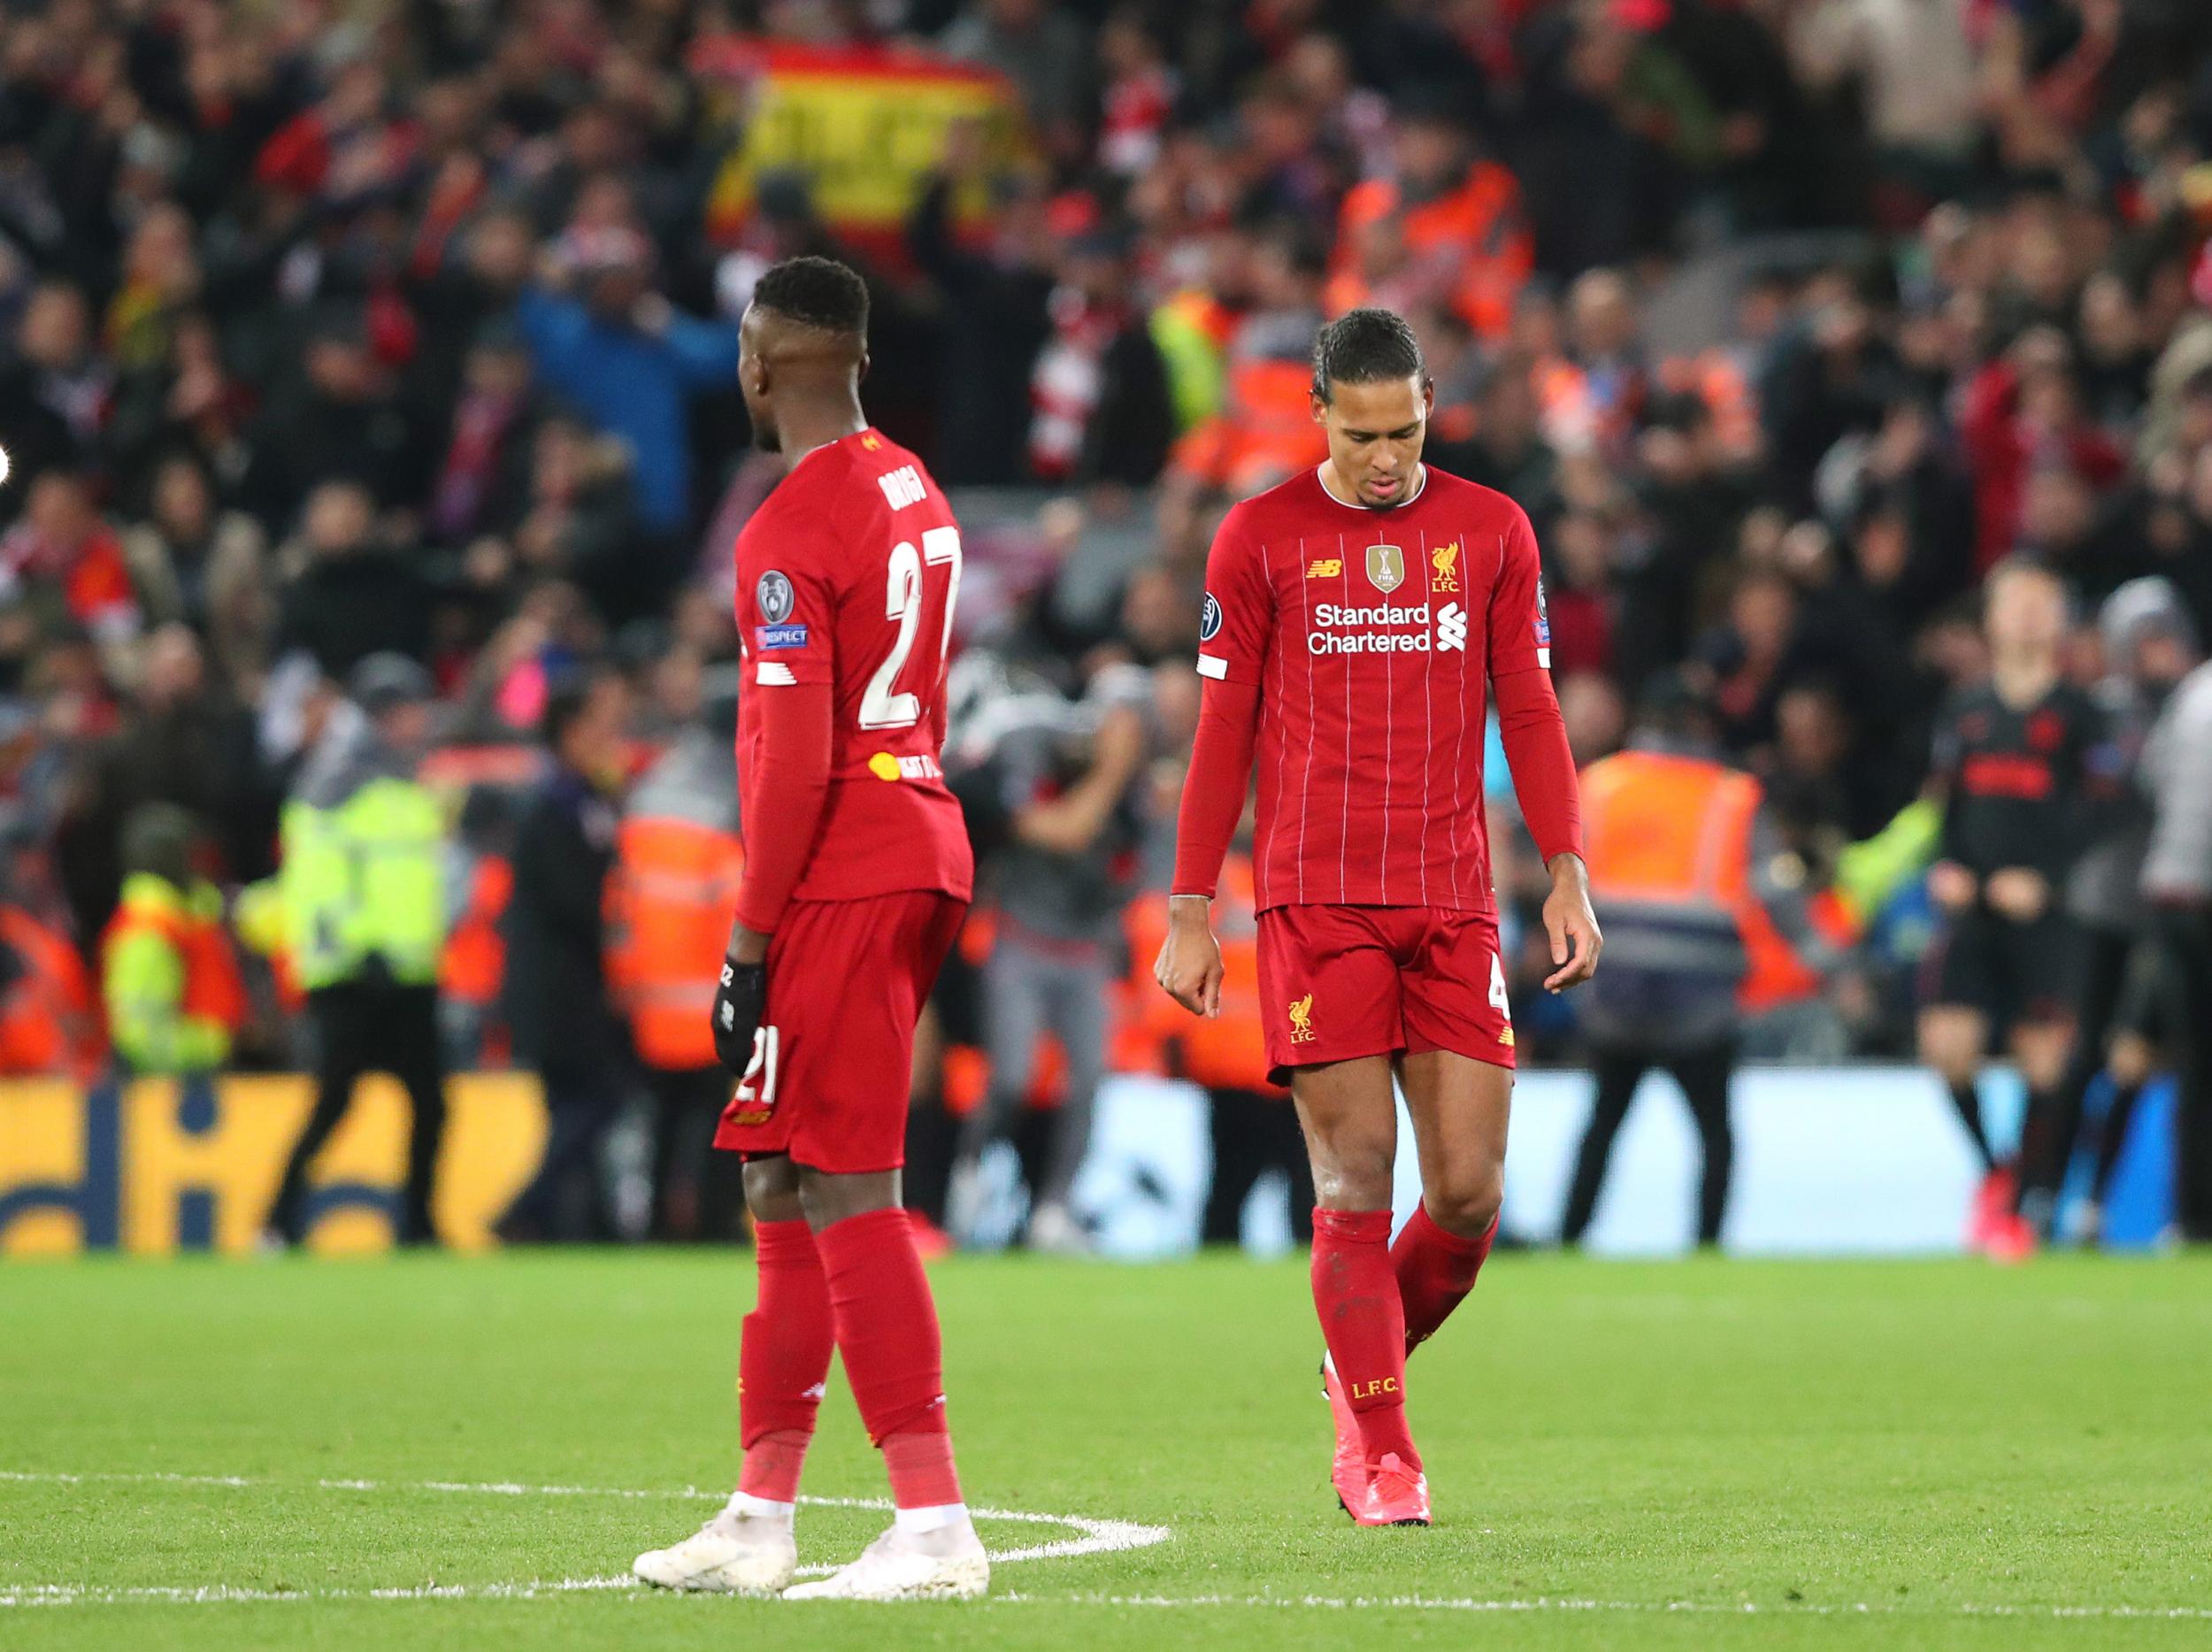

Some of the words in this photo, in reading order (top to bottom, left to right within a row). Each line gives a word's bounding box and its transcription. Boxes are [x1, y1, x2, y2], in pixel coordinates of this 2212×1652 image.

[857, 526, 962, 731] 27
[1315, 603, 1430, 627] Standard
[1308, 629, 1432, 655] Chartered
[1488, 951, 1511, 1020] 4
